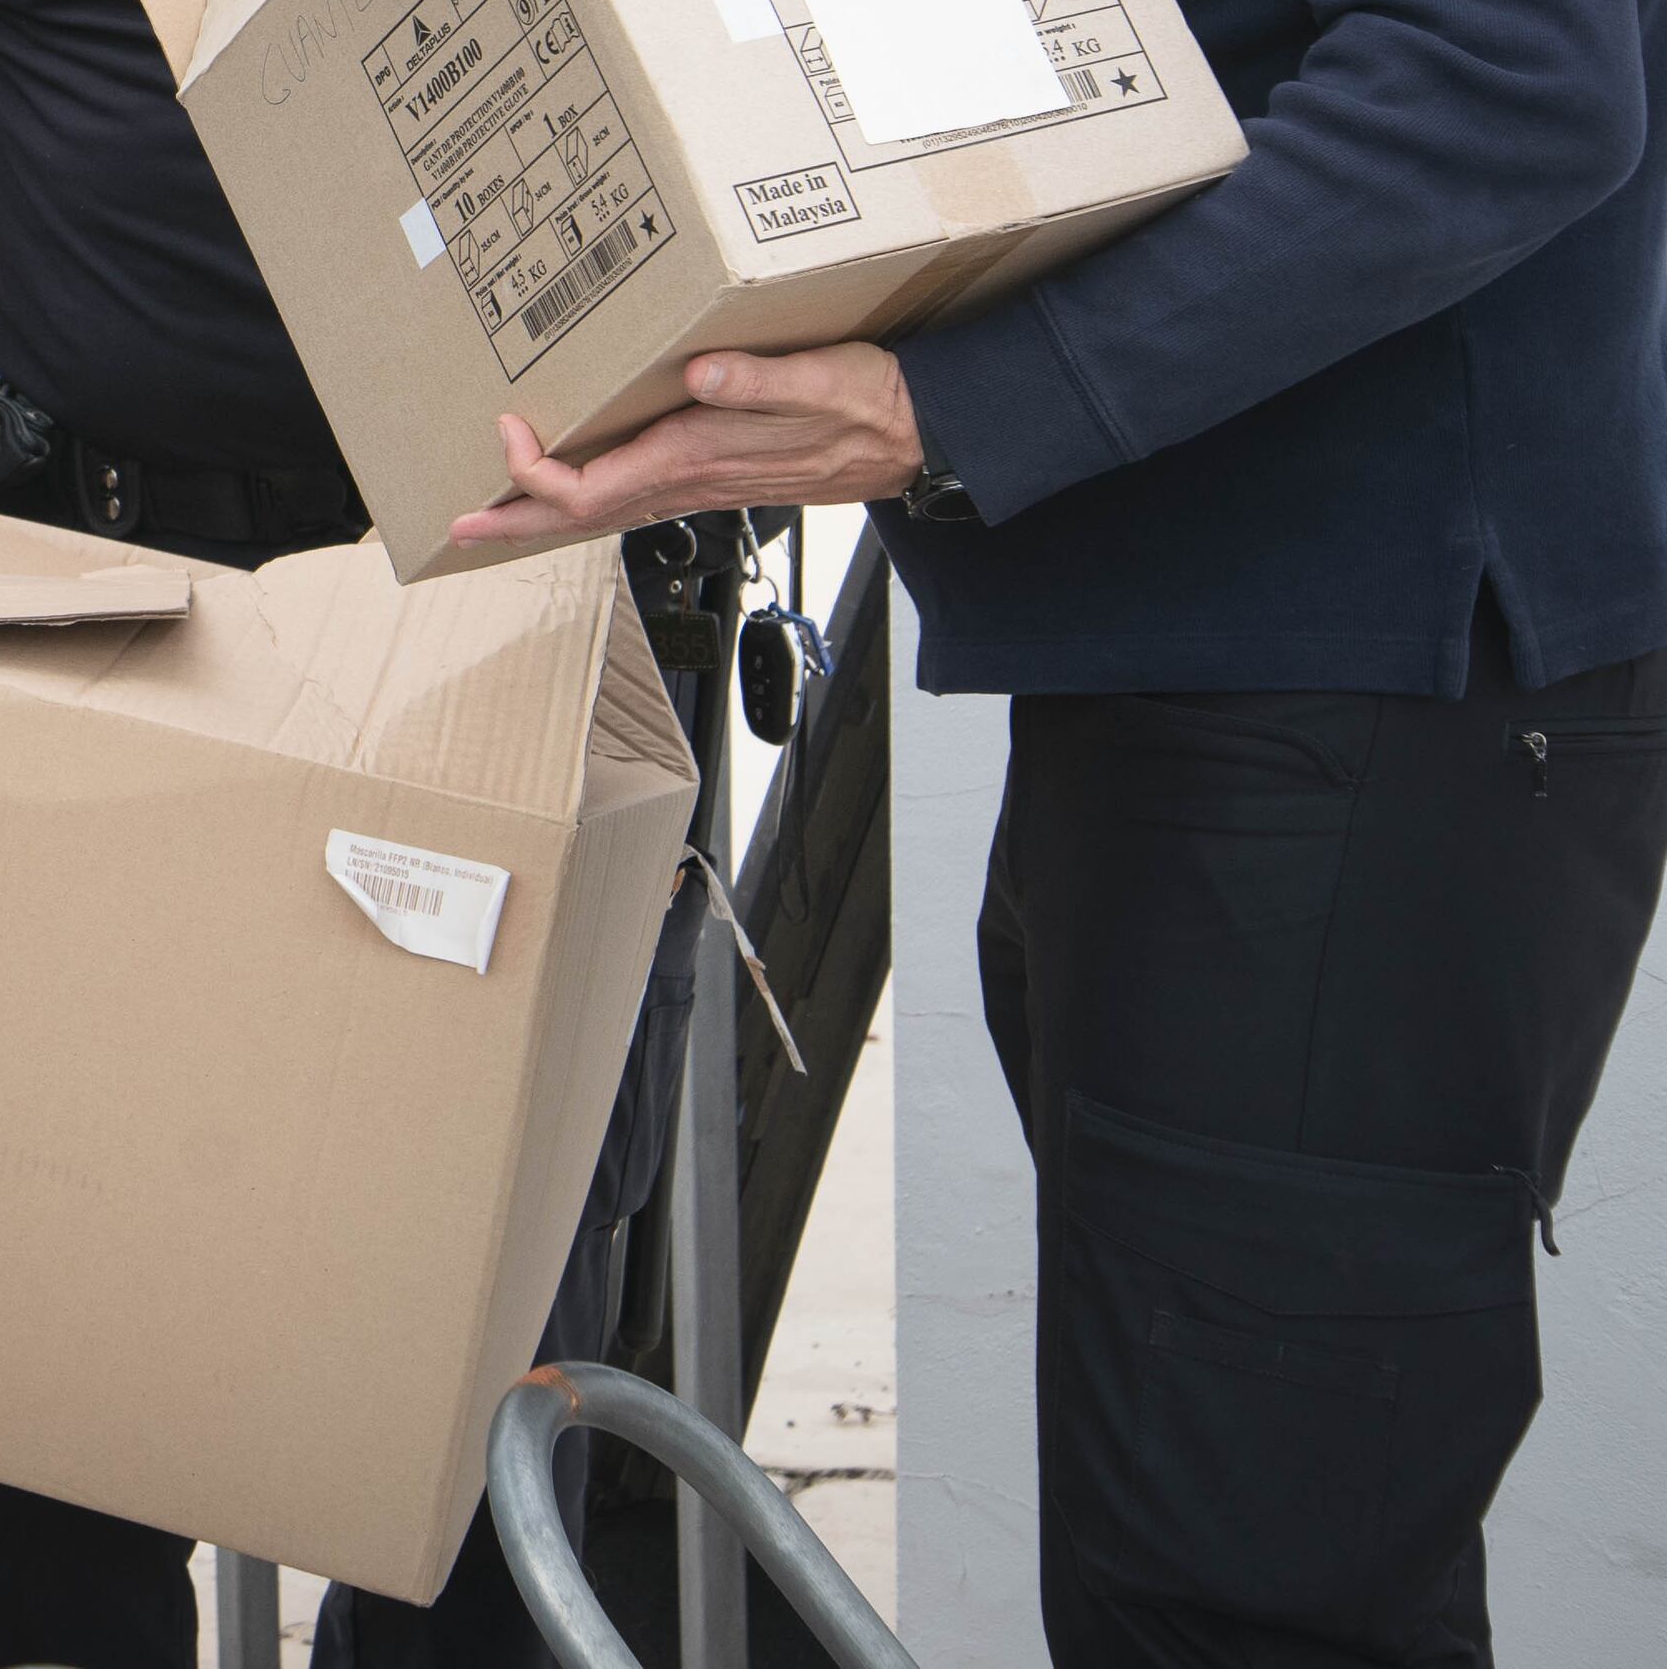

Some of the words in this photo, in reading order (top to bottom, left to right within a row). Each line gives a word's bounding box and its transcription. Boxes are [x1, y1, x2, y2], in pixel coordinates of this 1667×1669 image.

[405, 21, 451, 72] DELTAPLUS
[1071, 37, 1102, 57] KG
[374, 64, 391, 86] DPG
[404, 35, 484, 126] V1400B100
[422, 147, 443, 172] GANT
[440, 137, 453, 154] DE
[449, 96, 494, 145] PROTECTION
[462, 106, 505, 153] PROTECTIVE
[502, 82, 529, 113] GLOVE
[541, 111, 557, 139] 1
[557, 102, 578, 129] BOX
[452, 189, 477, 224] 10
[476, 173, 505, 206] BOXES
[589, 191, 608, 216] 5.4
[609, 181, 630, 208] KG
[745, 179, 803, 205] Made
[805, 174, 828, 191] in
[757, 197, 847, 232] Malaysia
[508, 267, 526, 292] 4.5
[527, 257, 548, 284] KG
[350, 844, 387, 862] Mascarilla
[388, 852, 408, 866] FFP2
